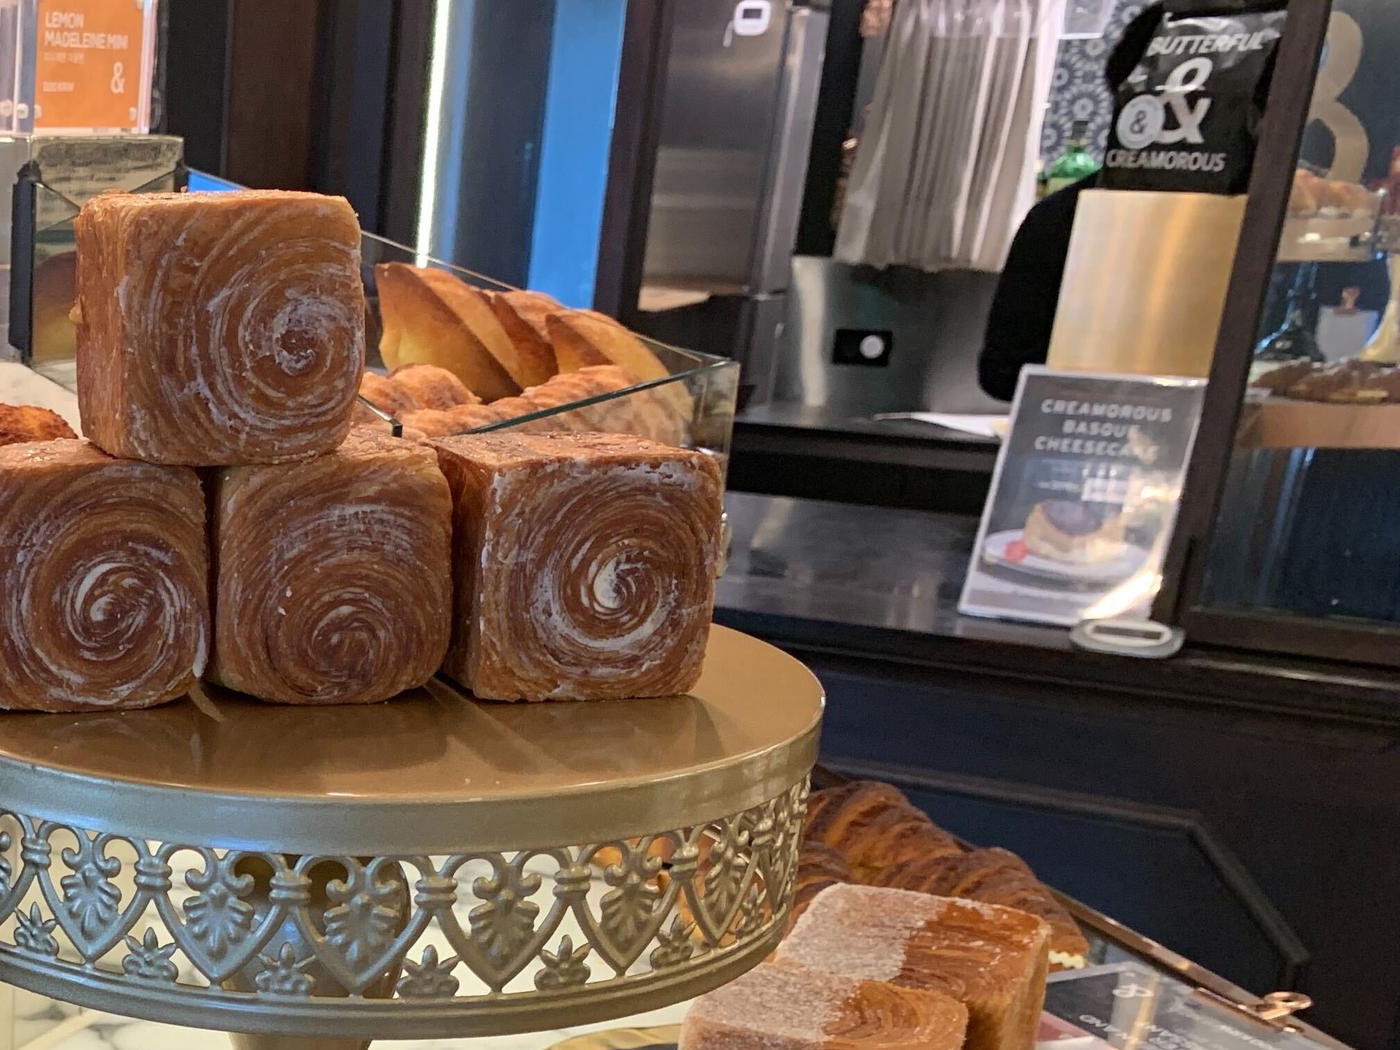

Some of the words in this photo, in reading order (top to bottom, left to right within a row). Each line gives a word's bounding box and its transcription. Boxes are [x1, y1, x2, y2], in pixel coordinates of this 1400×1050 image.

[45, 12, 84, 28] LEMON
[1147, 31, 1265, 56] BUTTERFUL
[110, 62, 125, 93] &
[1105, 150, 1227, 172] CREAMOROUS
[1041, 399, 1172, 423] CREAMOROUS
[1034, 436, 1159, 461] CHEESECA
